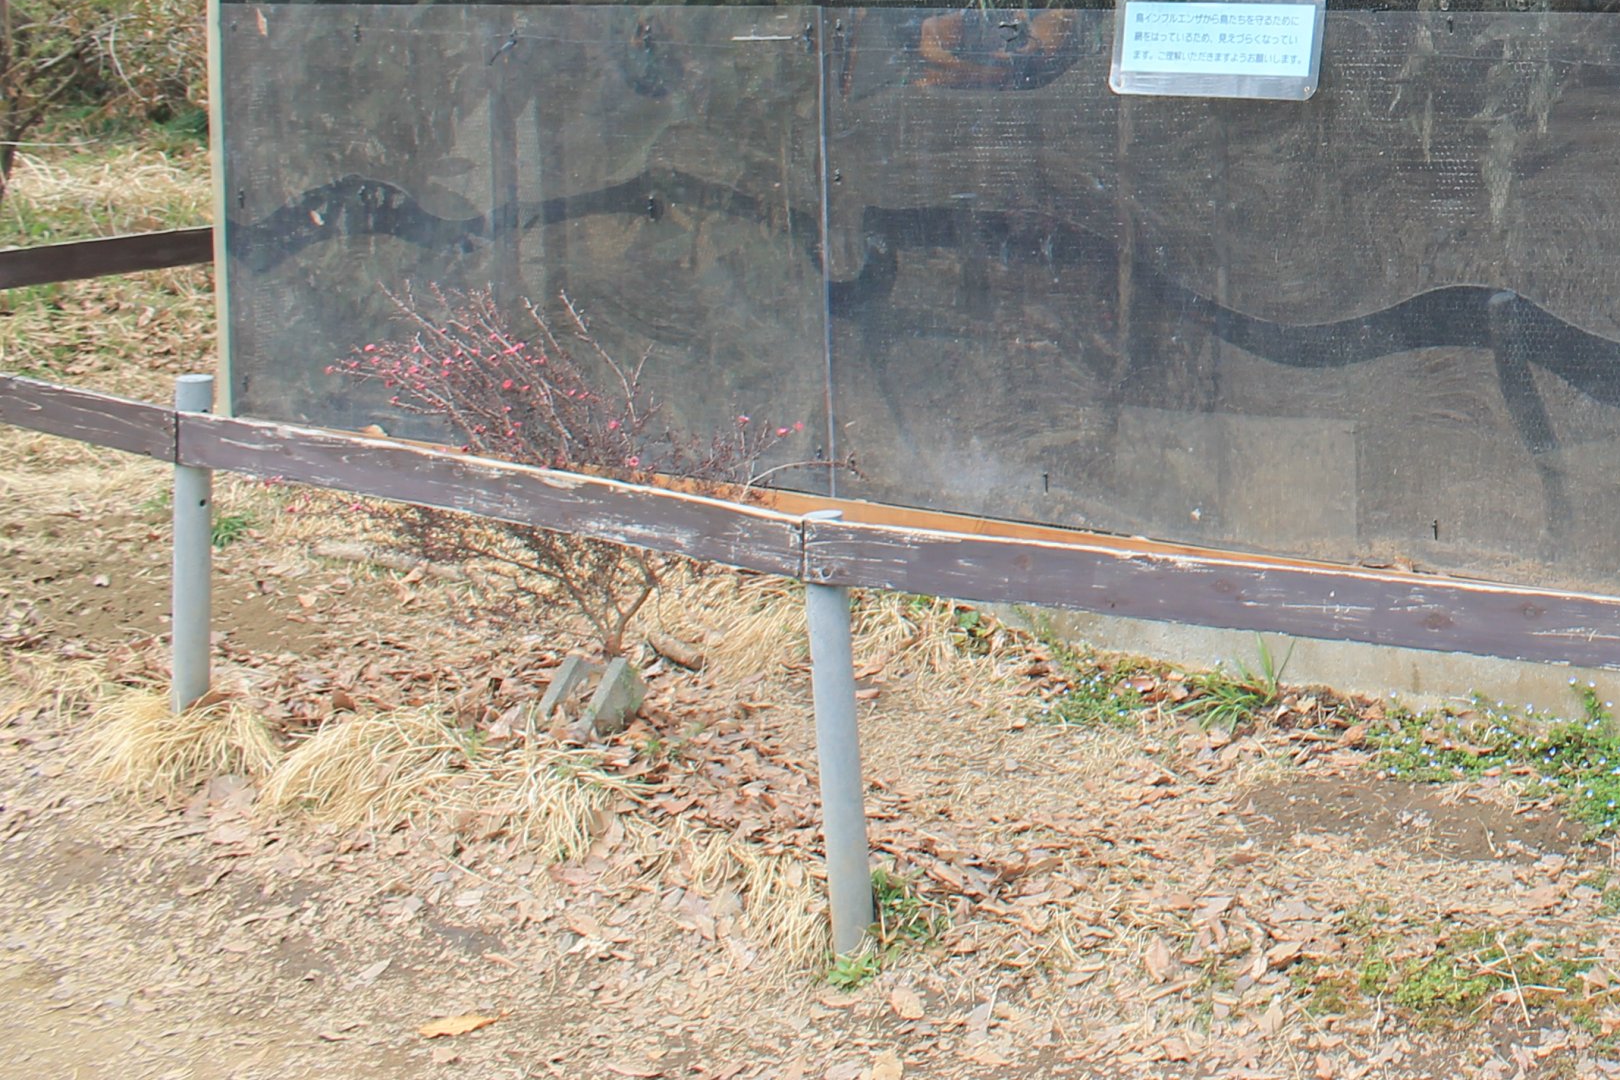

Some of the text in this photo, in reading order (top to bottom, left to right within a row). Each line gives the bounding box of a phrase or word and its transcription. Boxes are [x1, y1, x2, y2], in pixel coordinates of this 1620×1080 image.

[1135, 12, 1300, 26] 鳥インフルエンザから鳥たちを守るために
